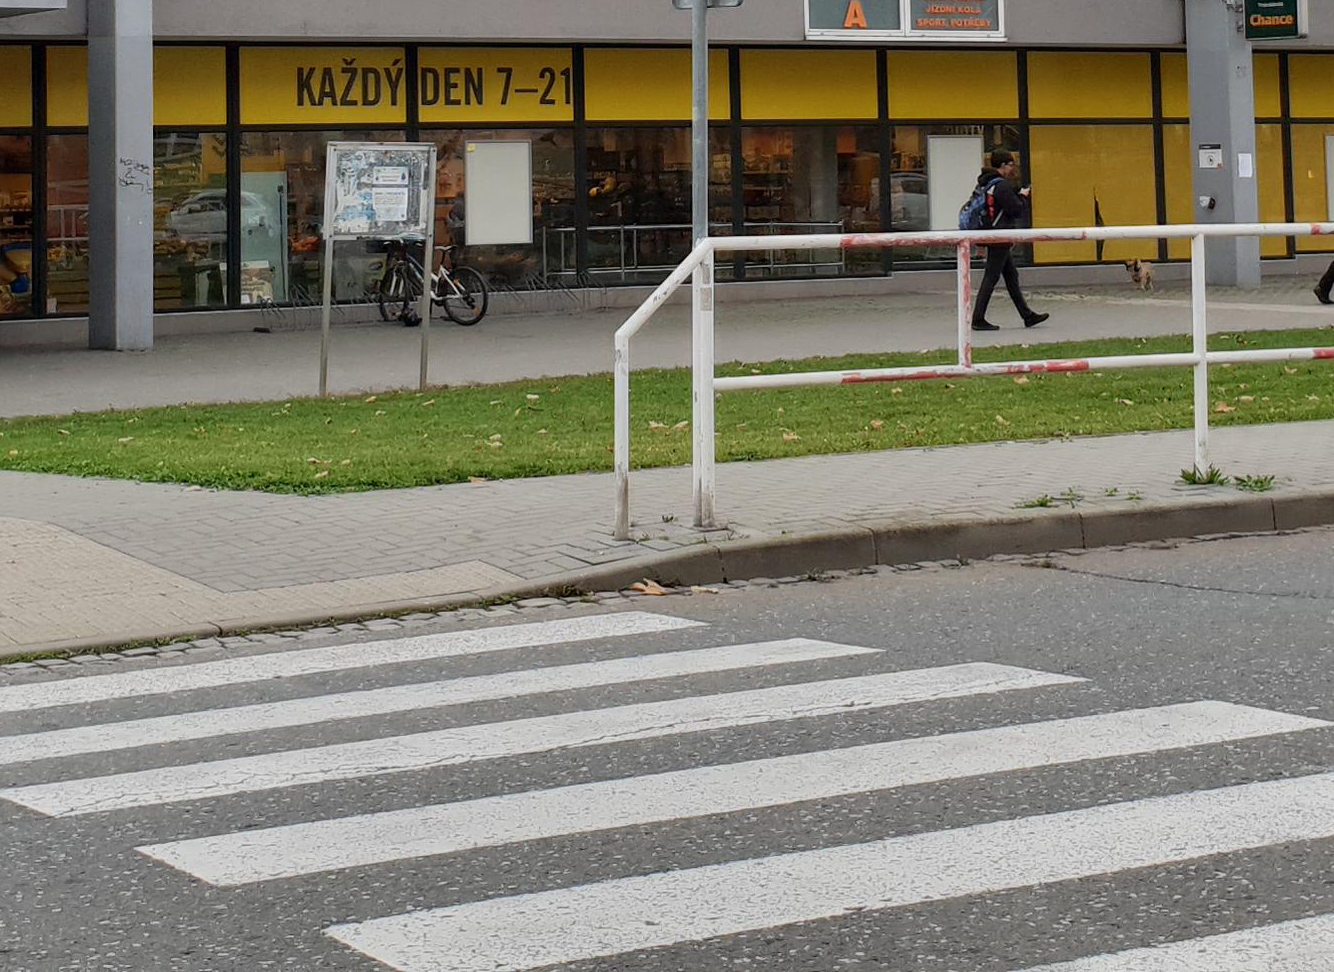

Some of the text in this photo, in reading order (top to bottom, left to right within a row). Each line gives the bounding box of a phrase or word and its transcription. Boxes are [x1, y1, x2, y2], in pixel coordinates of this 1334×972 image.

[1249, 14, 1295, 26] Chance
[296, 58, 404, 107] KAŽDÝ
[421, 67, 484, 106] DEN
